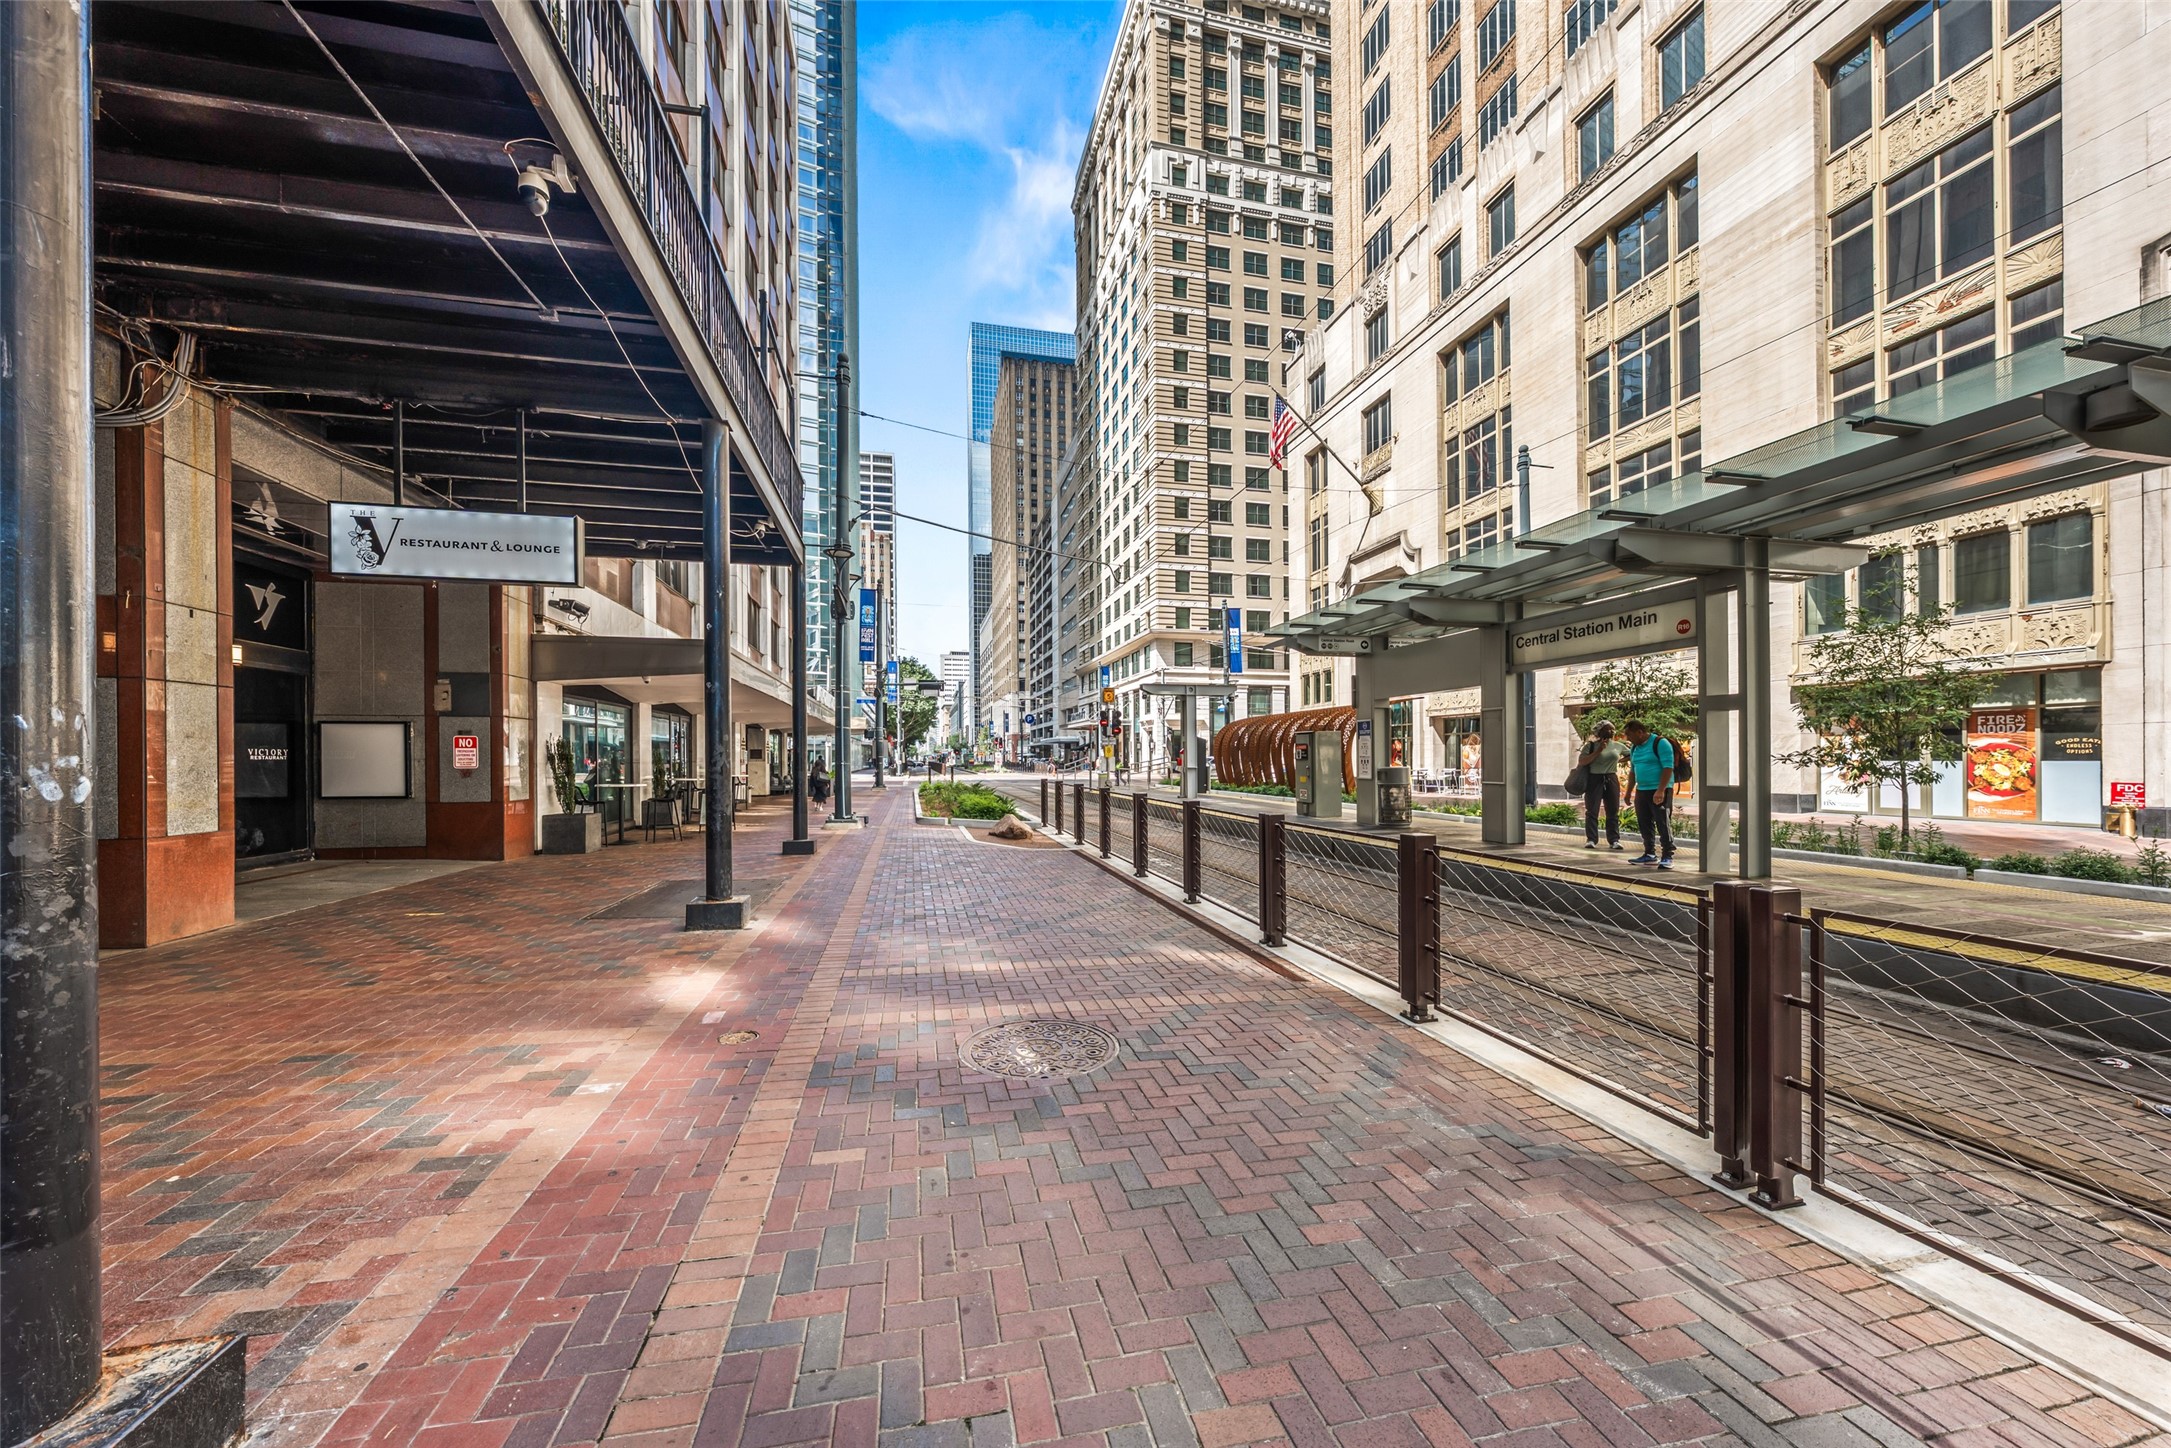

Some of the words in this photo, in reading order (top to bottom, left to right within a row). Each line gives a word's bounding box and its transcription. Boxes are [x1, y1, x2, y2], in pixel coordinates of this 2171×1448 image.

[350, 515, 404, 566] V
[400, 538, 488, 551] RESTAURANT
[490, 540, 504, 553] &
[505, 543, 561, 554] LOUNGE
[1515, 628, 1560, 649] Central
[1563, 620, 1614, 641] Station
[1618, 611, 1658, 630] Main
[1977, 714, 2015, 725] FIRE
[1977, 723, 2026, 734] NOODZ
[459, 738, 473, 747] NO
[2055, 737, 2080, 745] GOOD
[247, 748, 288, 756] VICTORY
[2116, 784, 2144, 792] FDC
